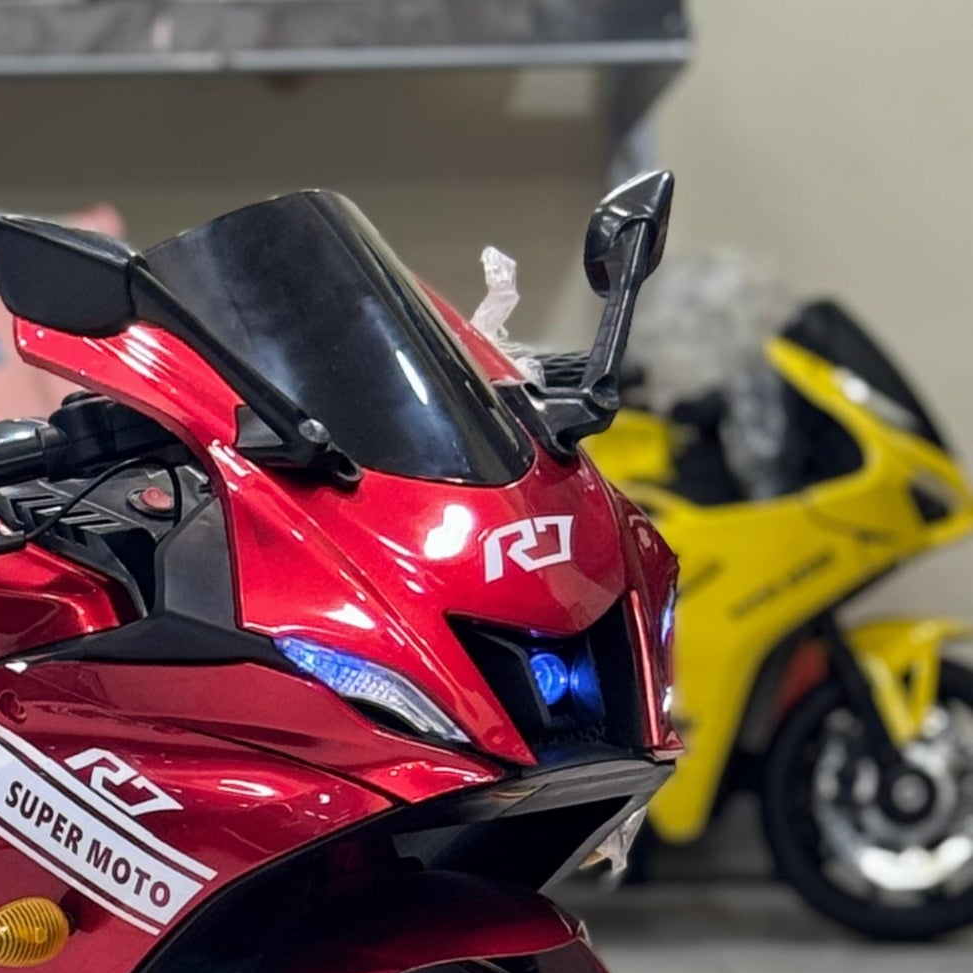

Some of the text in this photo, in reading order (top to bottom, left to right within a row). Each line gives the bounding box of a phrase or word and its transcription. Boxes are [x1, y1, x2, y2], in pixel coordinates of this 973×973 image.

[64, 748, 184, 816] R7
[4, 780, 171, 908] SUPER MOTO
